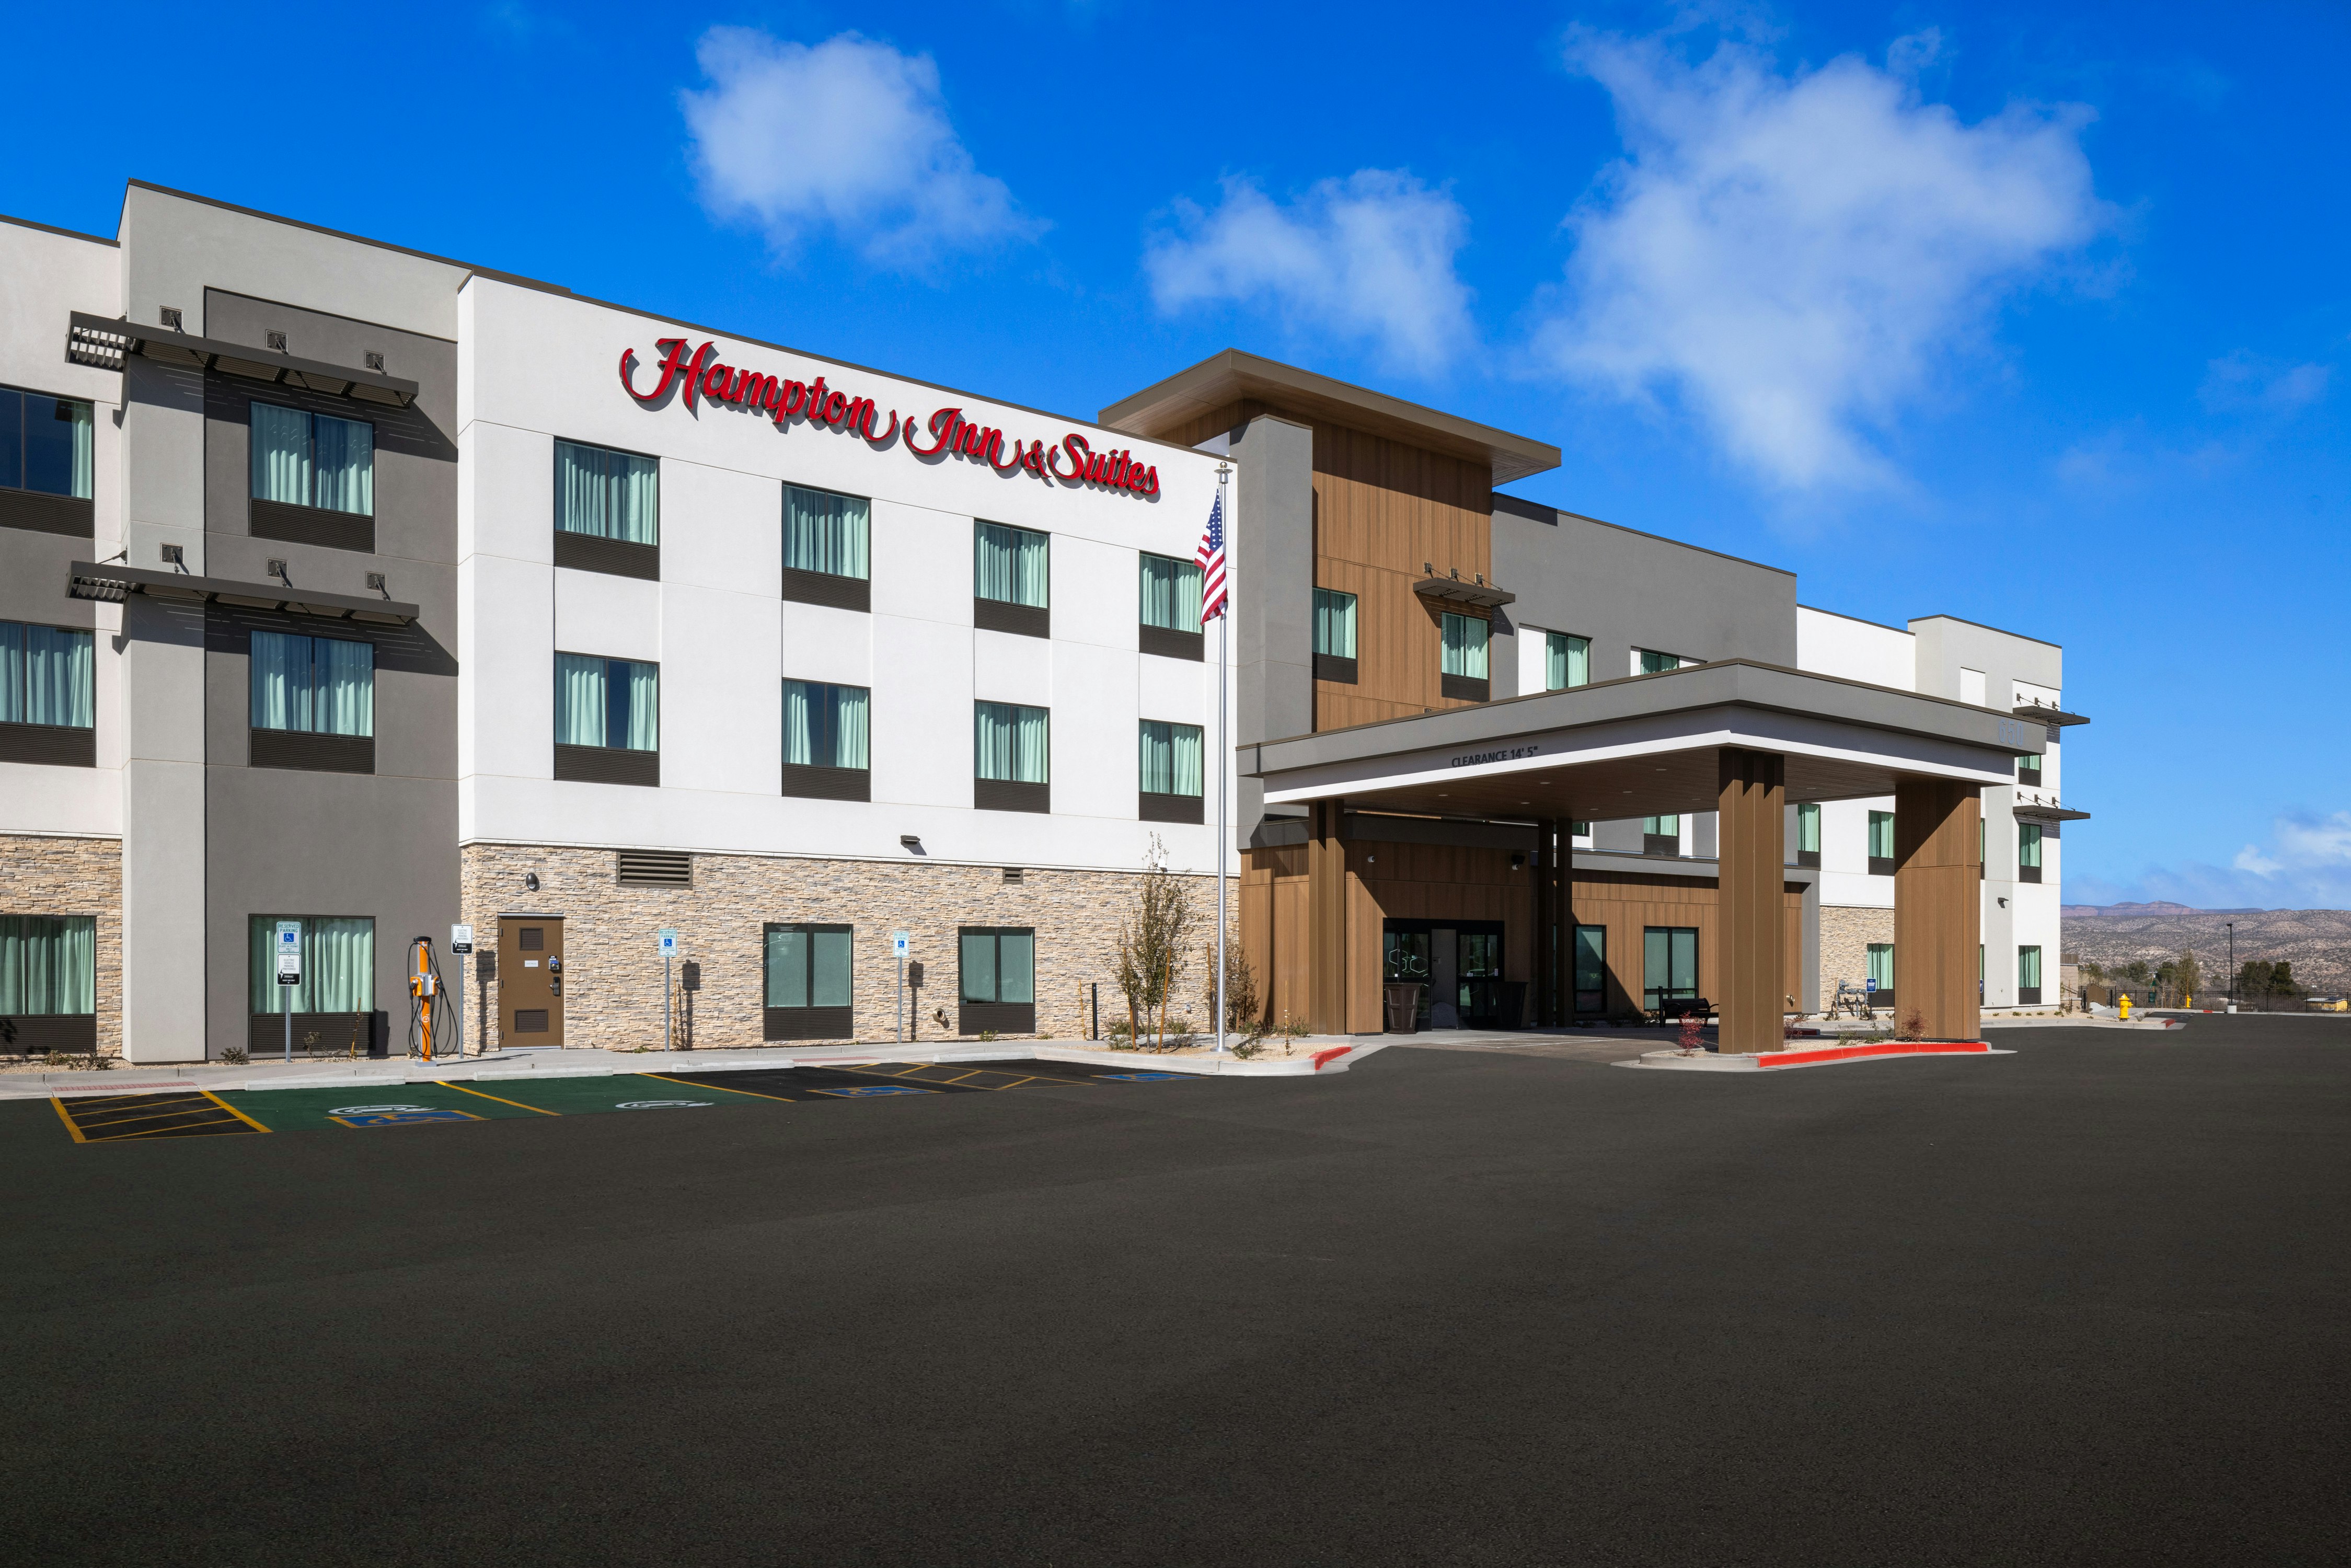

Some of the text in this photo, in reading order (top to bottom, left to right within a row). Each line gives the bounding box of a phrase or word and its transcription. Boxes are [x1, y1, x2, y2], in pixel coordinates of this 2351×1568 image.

[619, 338, 1159, 494] Hampton Inn & Suites
[1999, 719, 2023, 746] 650
[1451, 746, 1538, 767] CLEARANCE 14' 5"
